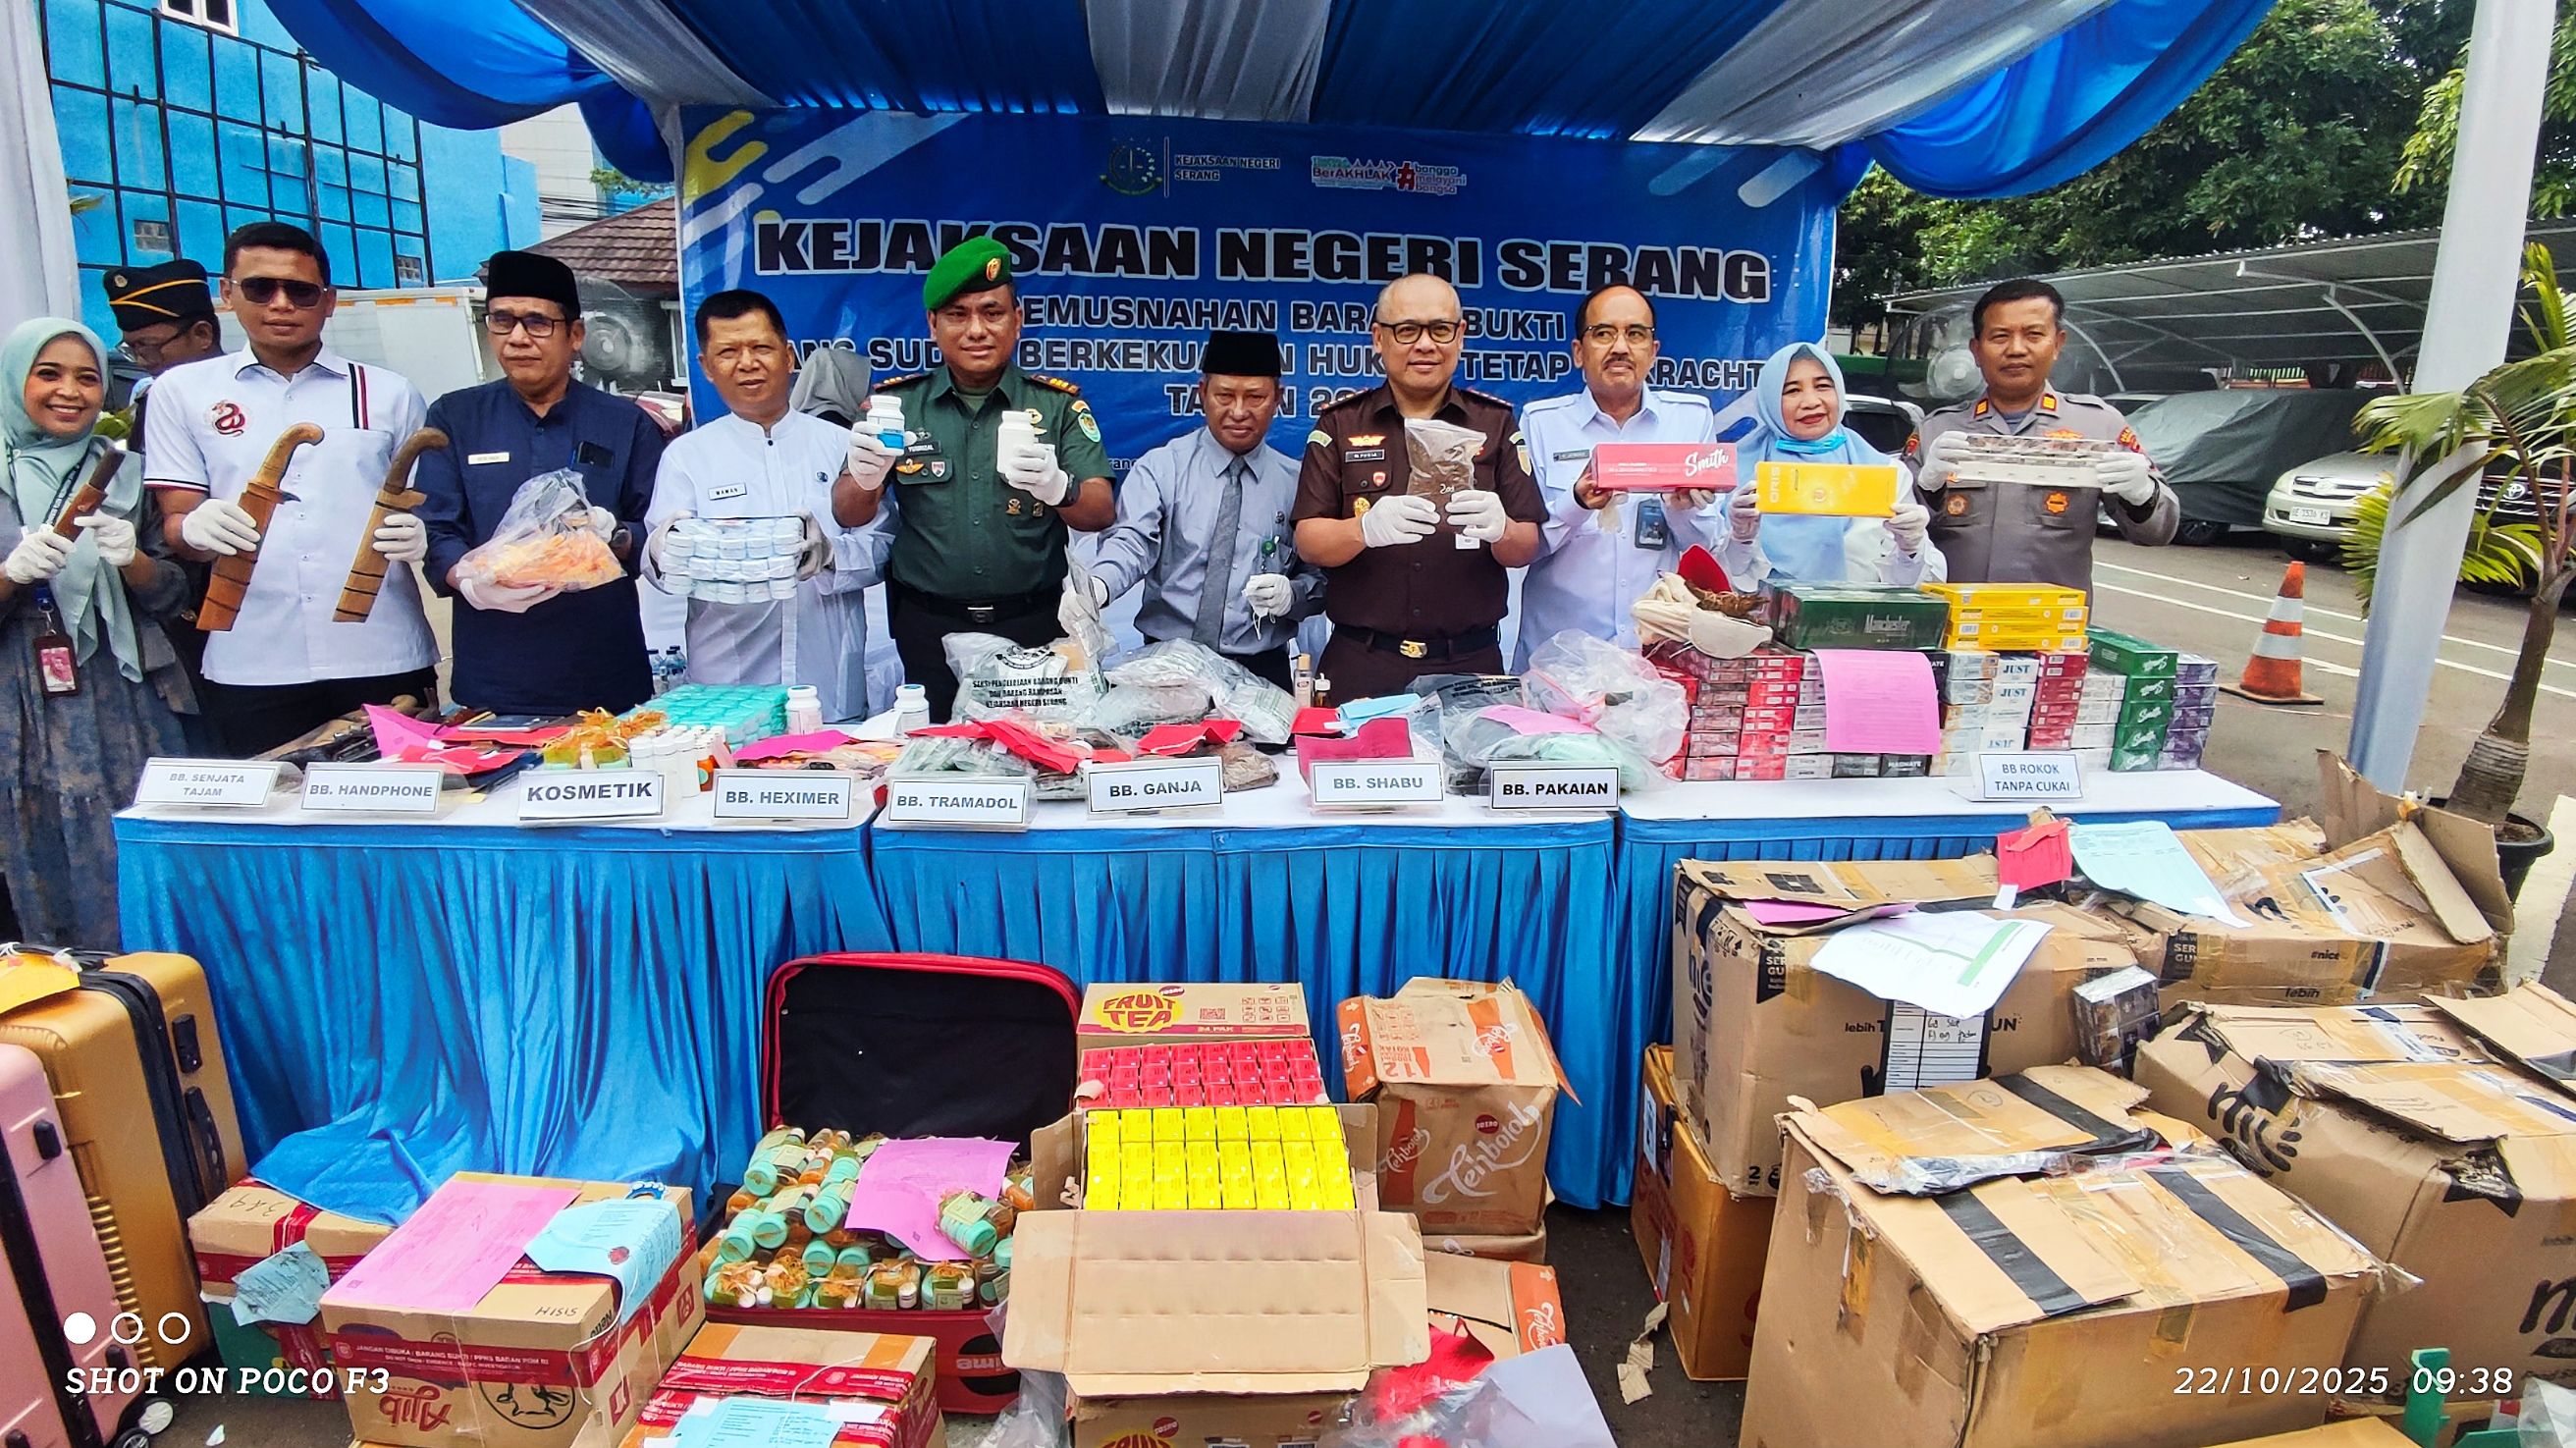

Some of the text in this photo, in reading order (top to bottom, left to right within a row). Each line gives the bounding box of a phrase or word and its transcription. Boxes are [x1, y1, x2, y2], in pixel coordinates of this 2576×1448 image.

[1175, 154, 1280, 169] KEJAKSAAN NEGERI
[1175, 170, 1219, 181] SERANG
[1314, 167, 1393, 181] BerAKHLAK
[1216, 227, 1483, 288] NEGERI
[1498, 237, 1771, 304] SERANG
[1021, 295, 1276, 332] EMUSNAHAN
[1467, 306, 1567, 342] BUKTI
[868, 338, 945, 372] SUD
[1308, 343, 1387, 378] HUK
[1466, 346, 1571, 383] TETAP
[1685, 449, 1729, 477] Smith
[2003, 665, 2030, 674] JUST
[2000, 688, 2026, 698] JUST
[2002, 763, 2061, 775] BB ROKOK
[170, 773, 244, 783] BB. SENJATA
[1333, 777, 1423, 789] BB. SHABU
[184, 787, 222, 797] TAJAM
[309, 785, 433, 797] BB. HANDPHONE
[527, 783, 653, 802] KOSMETIK
[1109, 780, 1203, 797] BB. GANJA
[1502, 782, 1608, 796] BB. PAKAIAN
[1995, 780, 2070, 792] TANPA CUKAI
[725, 790, 839, 805] BB. HEXIMER
[896, 795, 1018, 810] BB. TRAMADOL
[1103, 993, 1176, 1010] FRUIT
[1102, 1010, 1172, 1028] TEA
[1845, 1022, 1876, 1033] lebih
[1422, 1099, 1543, 1205] Tehbotol
